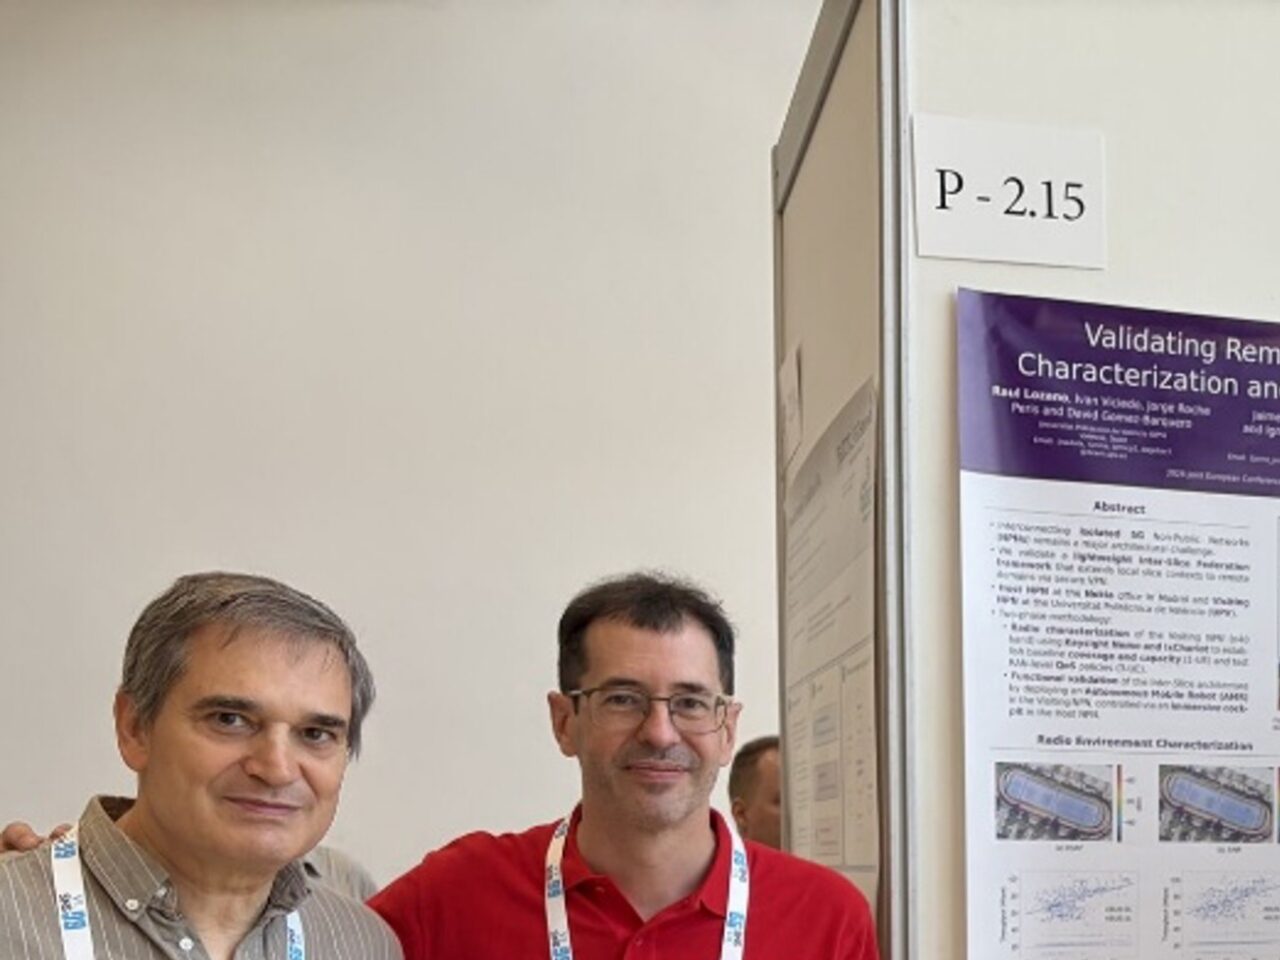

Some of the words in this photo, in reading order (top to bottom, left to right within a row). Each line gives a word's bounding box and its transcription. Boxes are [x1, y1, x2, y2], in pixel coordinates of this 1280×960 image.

[935, 168, 964, 210] P
[1003, 176, 1085, 221] 2.15
[1084, 322, 1216, 364] Validating
[1017, 352, 1239, 396] Characterization
[1043, 405, 1064, 418] and
[1067, 407, 1098, 421] David
[1242, 424, 1262, 435] and
[1093, 500, 1147, 515] Abstract
[1036, 733, 1072, 746] Radio
[1075, 735, 1153, 749] Environment
[1156, 738, 1254, 752] Characterization
